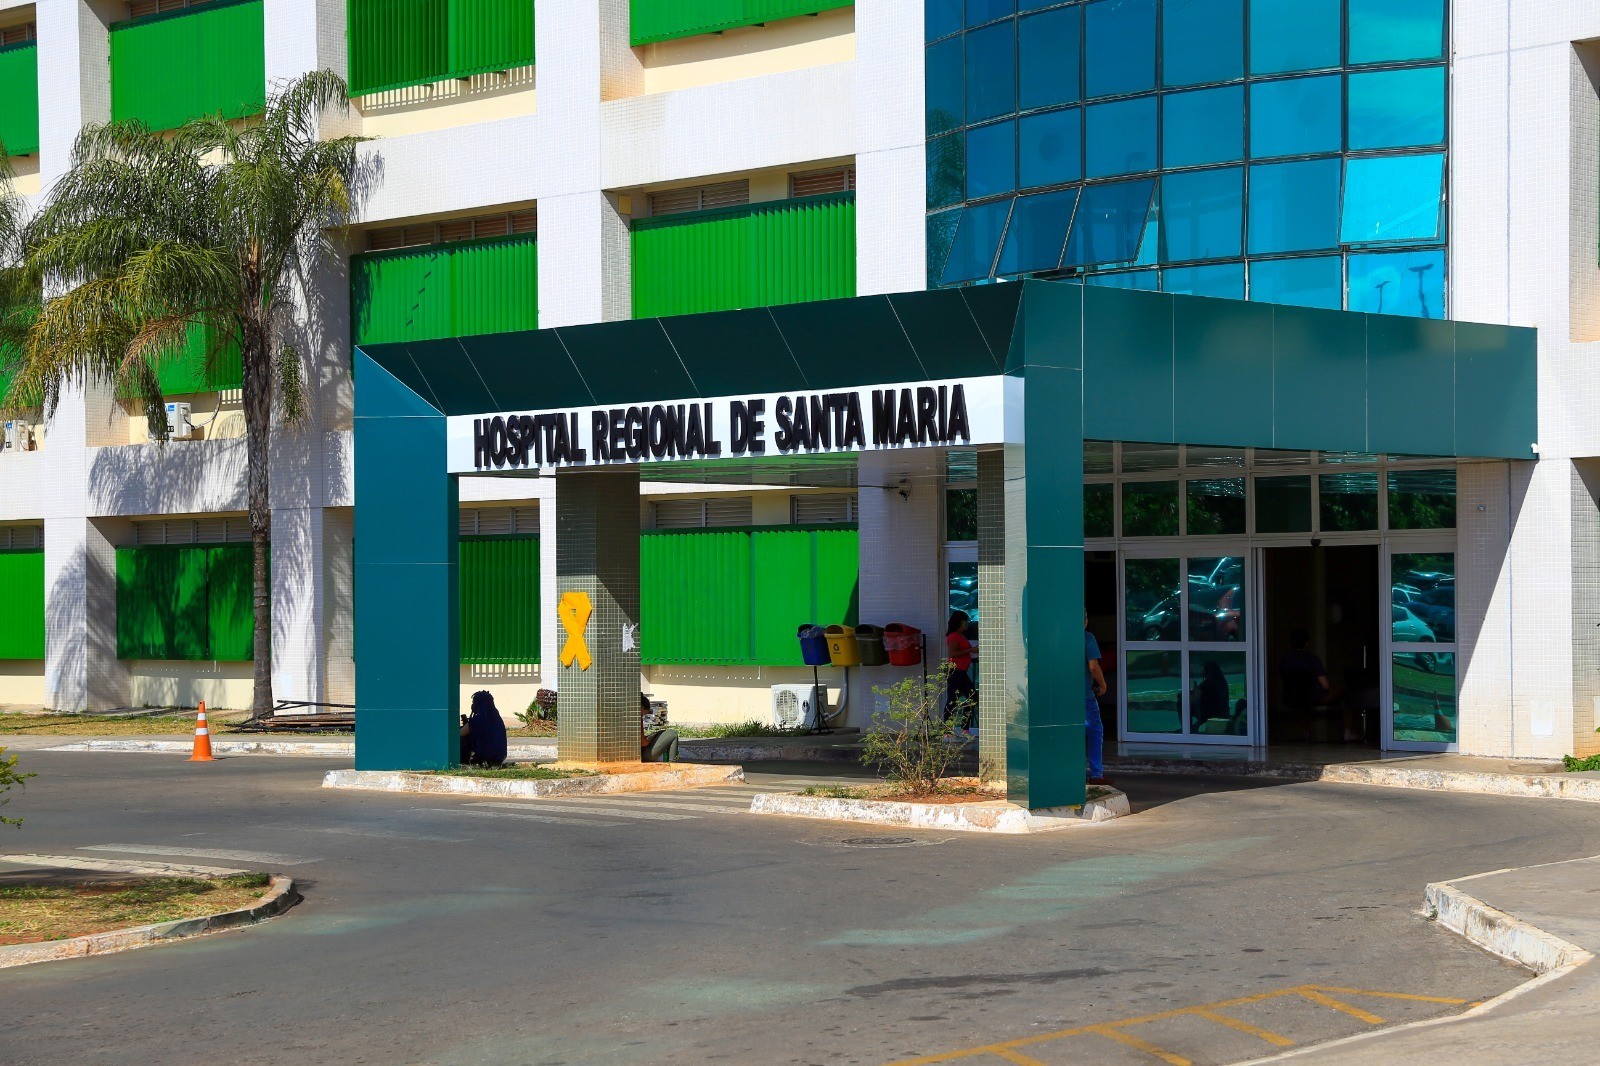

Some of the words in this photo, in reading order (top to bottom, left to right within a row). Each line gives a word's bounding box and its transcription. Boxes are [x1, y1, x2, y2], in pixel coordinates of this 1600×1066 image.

[474, 412, 587, 468] HOSPITAL
[591, 403, 721, 462] REGIONAL
[730, 399, 766, 454] DE
[775, 391, 866, 451] SANTA
[872, 384, 970, 446] MARIA
